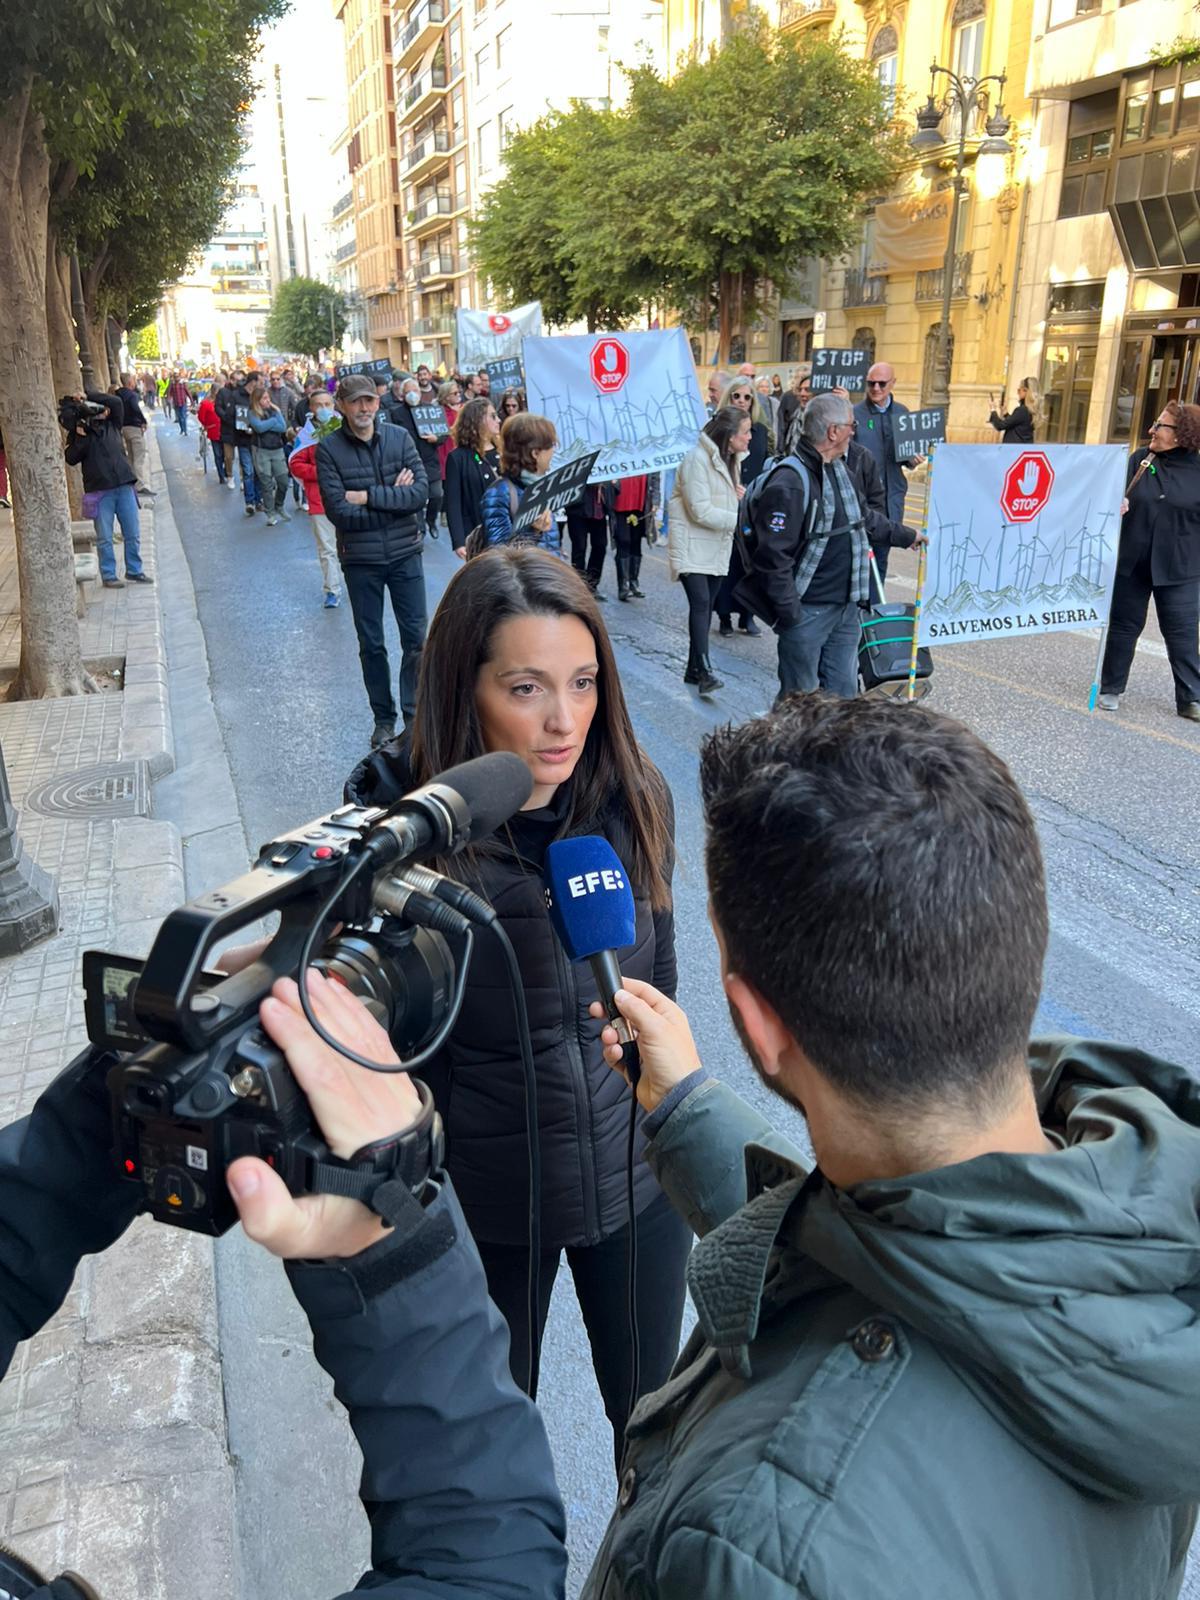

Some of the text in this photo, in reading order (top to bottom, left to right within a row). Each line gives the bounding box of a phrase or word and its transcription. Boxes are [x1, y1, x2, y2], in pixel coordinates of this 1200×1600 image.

[816, 350, 864, 367] STOP
[339, 364, 363, 376] STOP
[488, 360, 516, 374] STOP
[601, 373, 622, 384] STOP
[415, 407, 442, 419] STOP
[899, 412, 940, 431] STOP
[631, 459, 651, 470] LA
[527, 457, 591, 502] STOP
[1011, 498, 1039, 511] STOP
[929, 607, 1098, 637] SALVEMOS LA SIERRA
